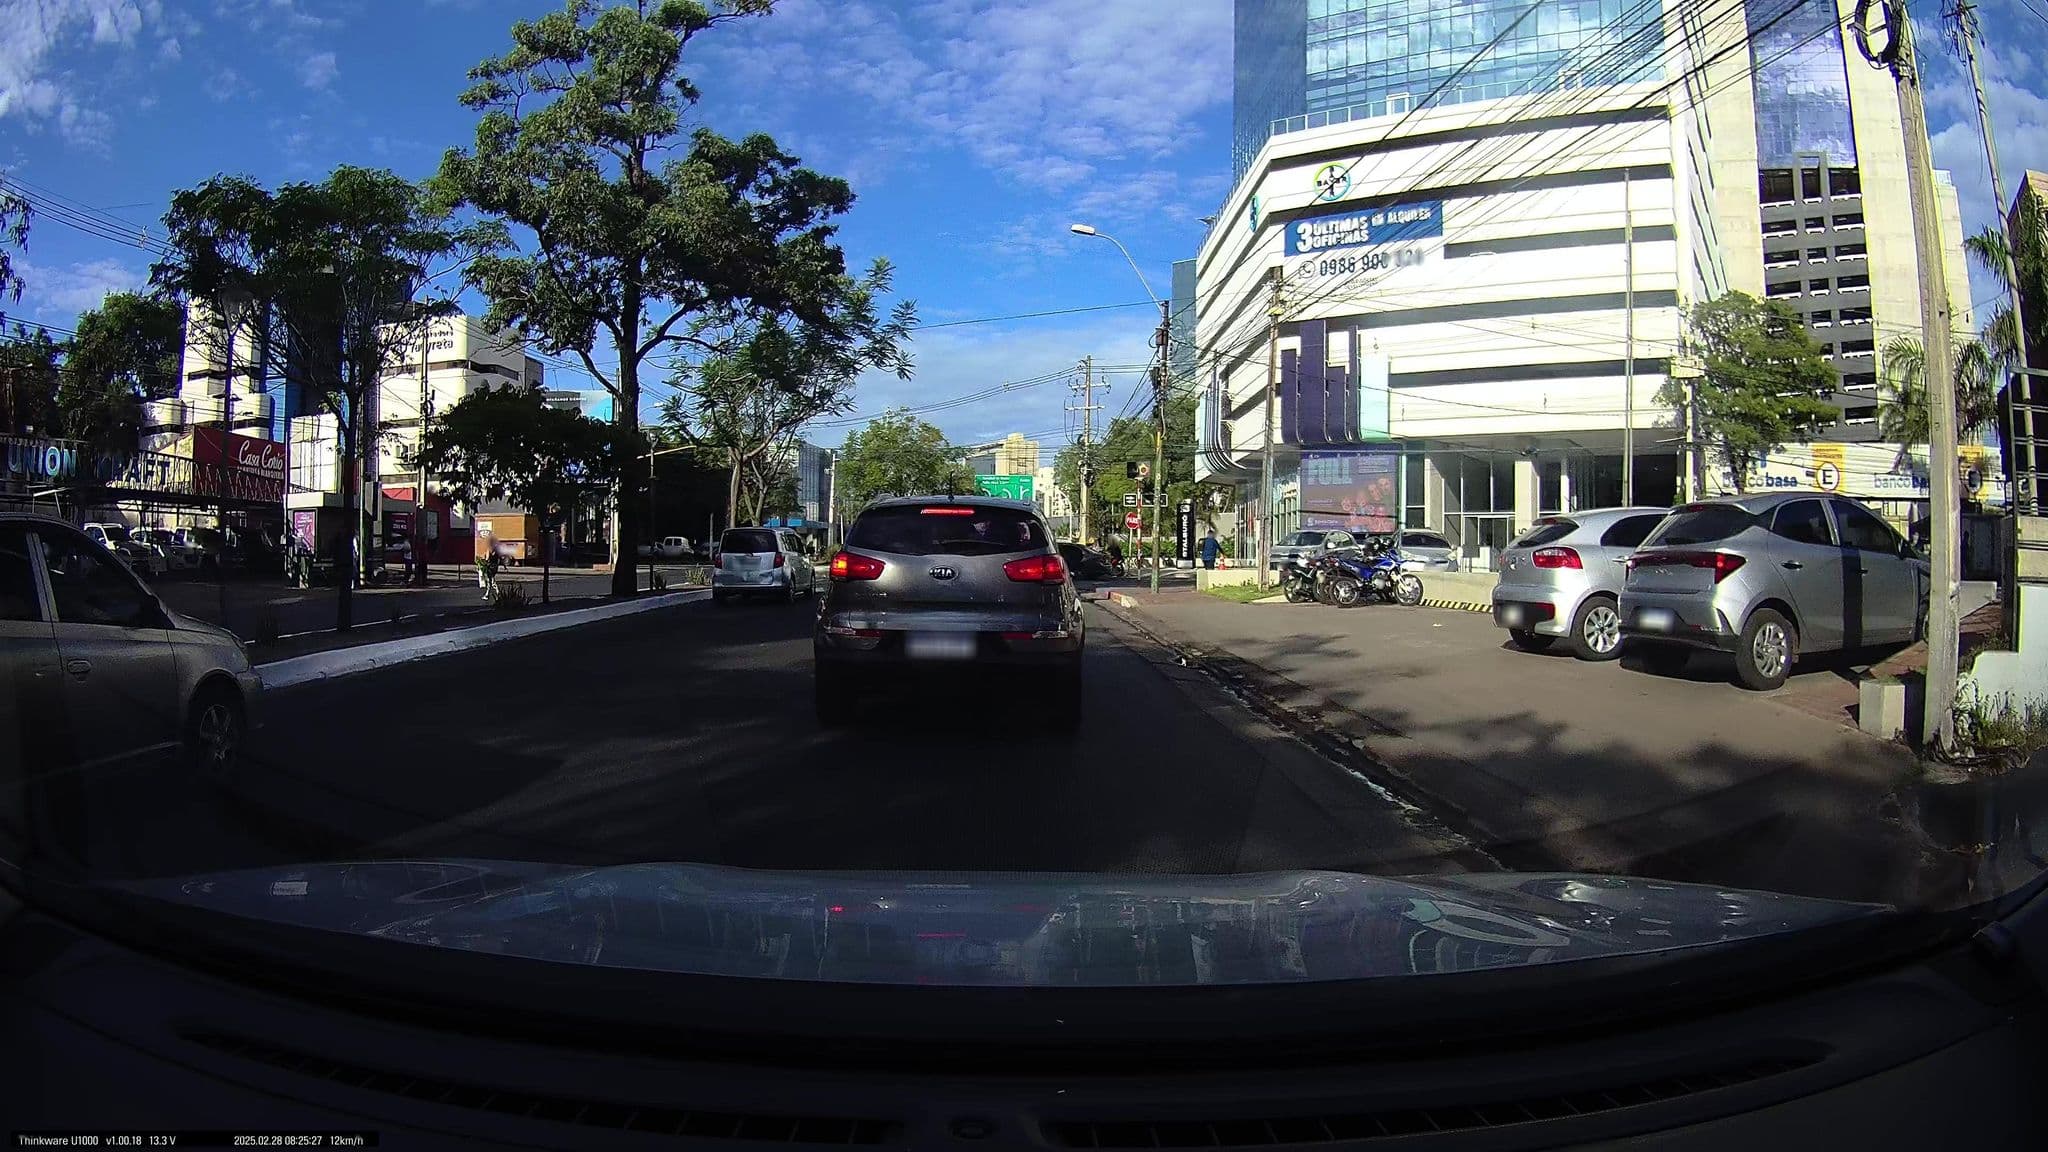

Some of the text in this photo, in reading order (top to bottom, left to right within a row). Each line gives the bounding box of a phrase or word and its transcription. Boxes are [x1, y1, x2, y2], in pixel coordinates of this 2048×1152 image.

[1296, 222, 1312, 252] 3
[1311, 230, 1369, 249] OFICINAS
[1320, 257, 1356, 276] 0986
[8, 446, 77, 477] UNION
[239, 440, 260, 467] Casa
[1722, 471, 1797, 488] bcobasa
[1822, 469, 1833, 485] E
[933, 568, 953, 578] KIA
